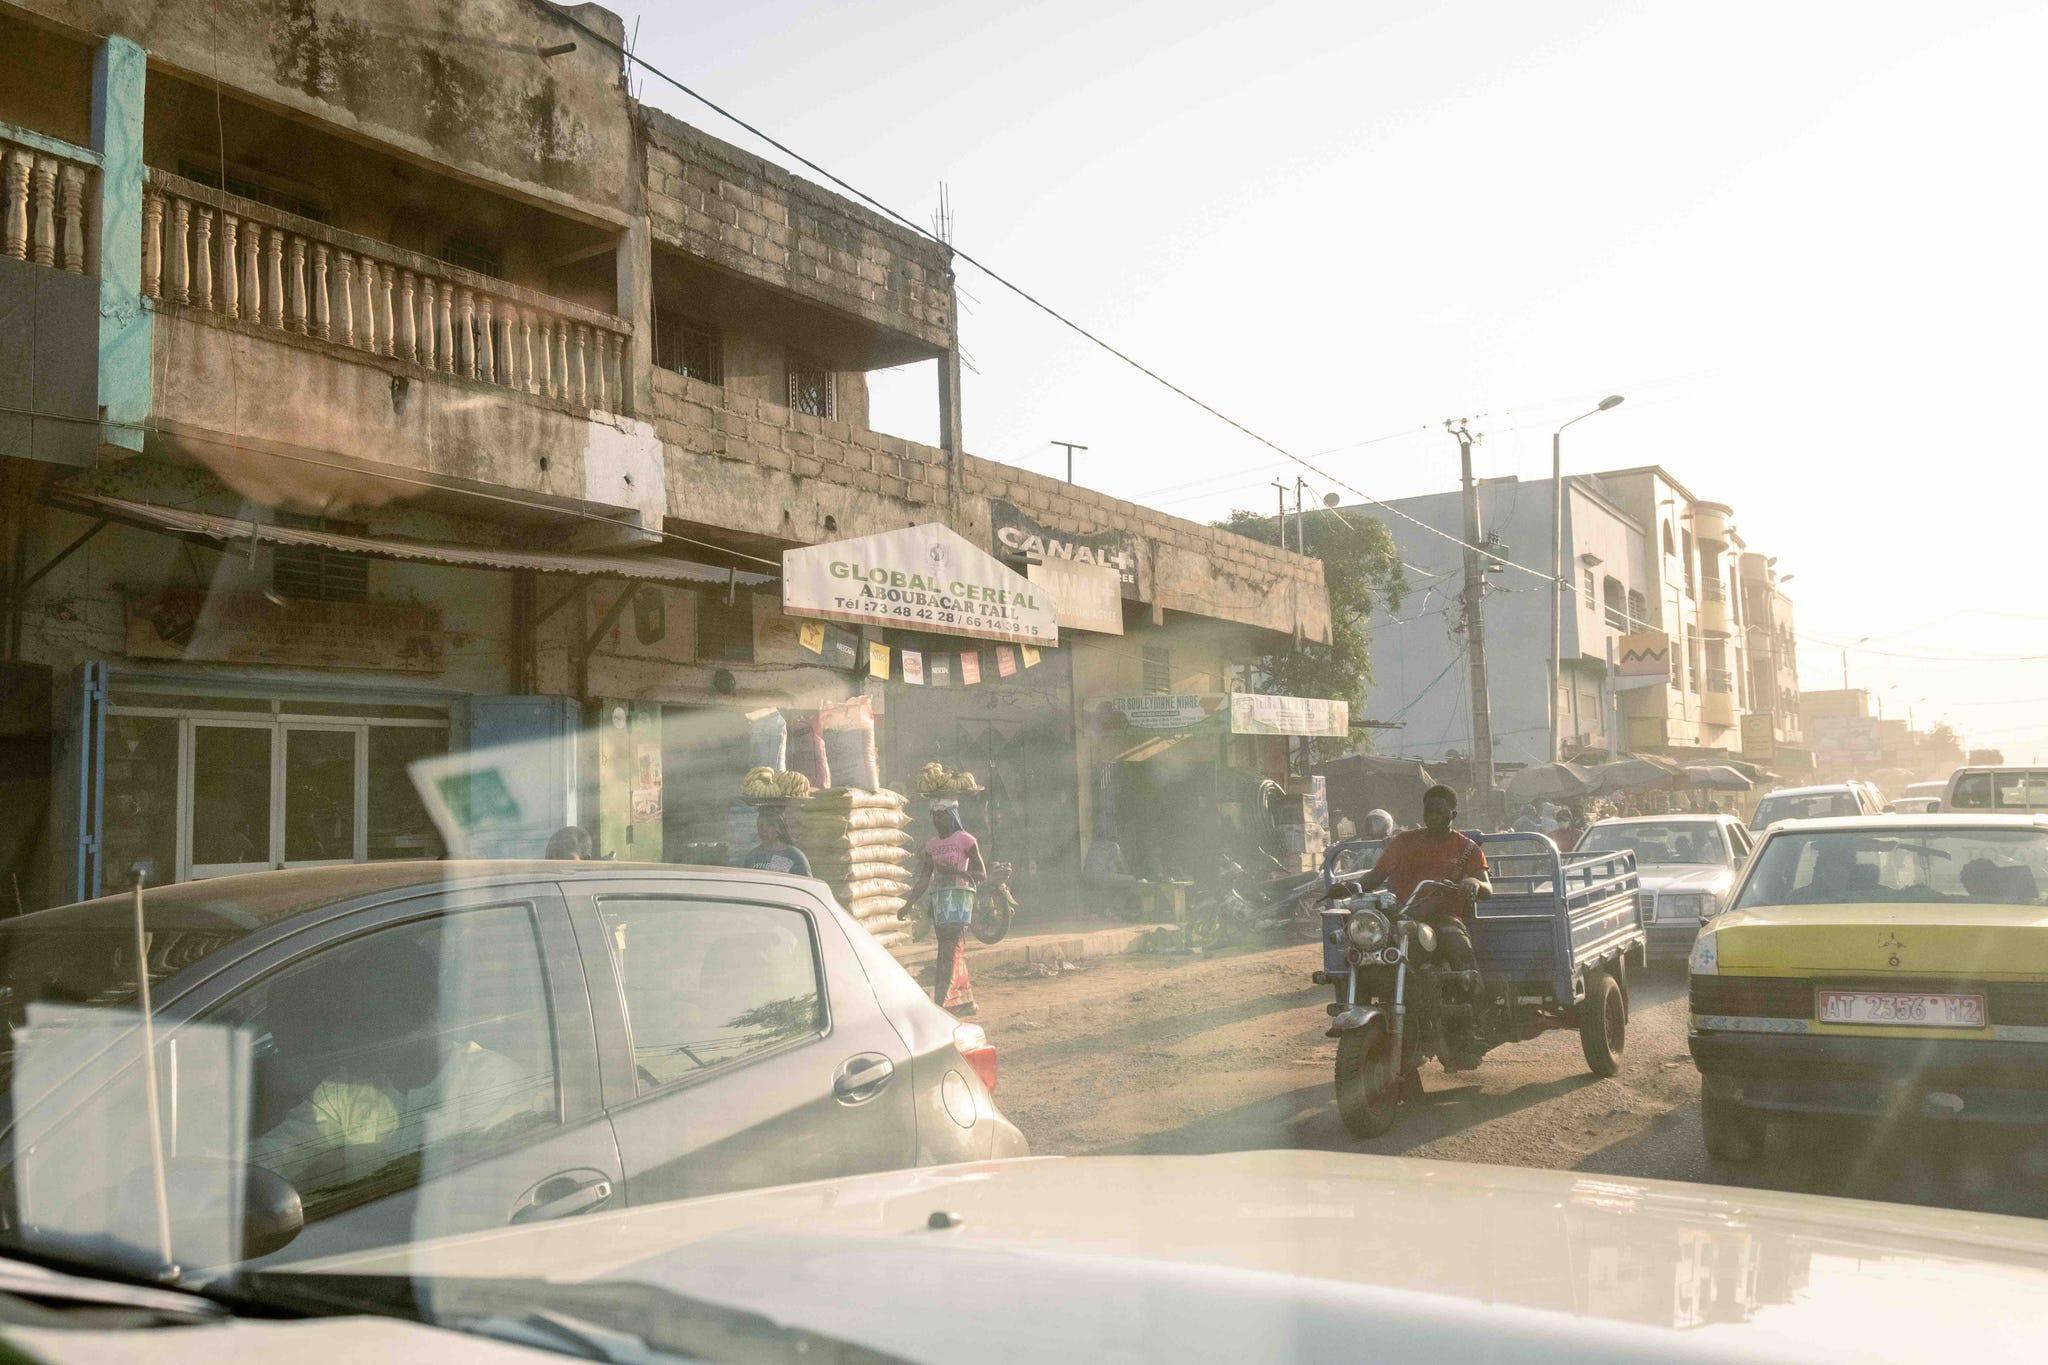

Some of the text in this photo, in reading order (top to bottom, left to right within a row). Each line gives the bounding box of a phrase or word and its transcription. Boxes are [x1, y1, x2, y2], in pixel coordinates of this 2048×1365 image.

[997, 526, 1135, 570] CANAL+
[829, 561, 1040, 611] GLOBAL CEREAL
[859, 583, 975, 614] ABOUBACAR
[893, 606, 912, 617] 48
[916, 608, 933, 620] 42
[937, 611, 954, 623] 28
[966, 616, 981, 627] 66
[986, 619, 1002, 630] 14
[1024, 624, 1039, 636] 15
[1825, 995, 1979, 1022] AT 2356 M2
